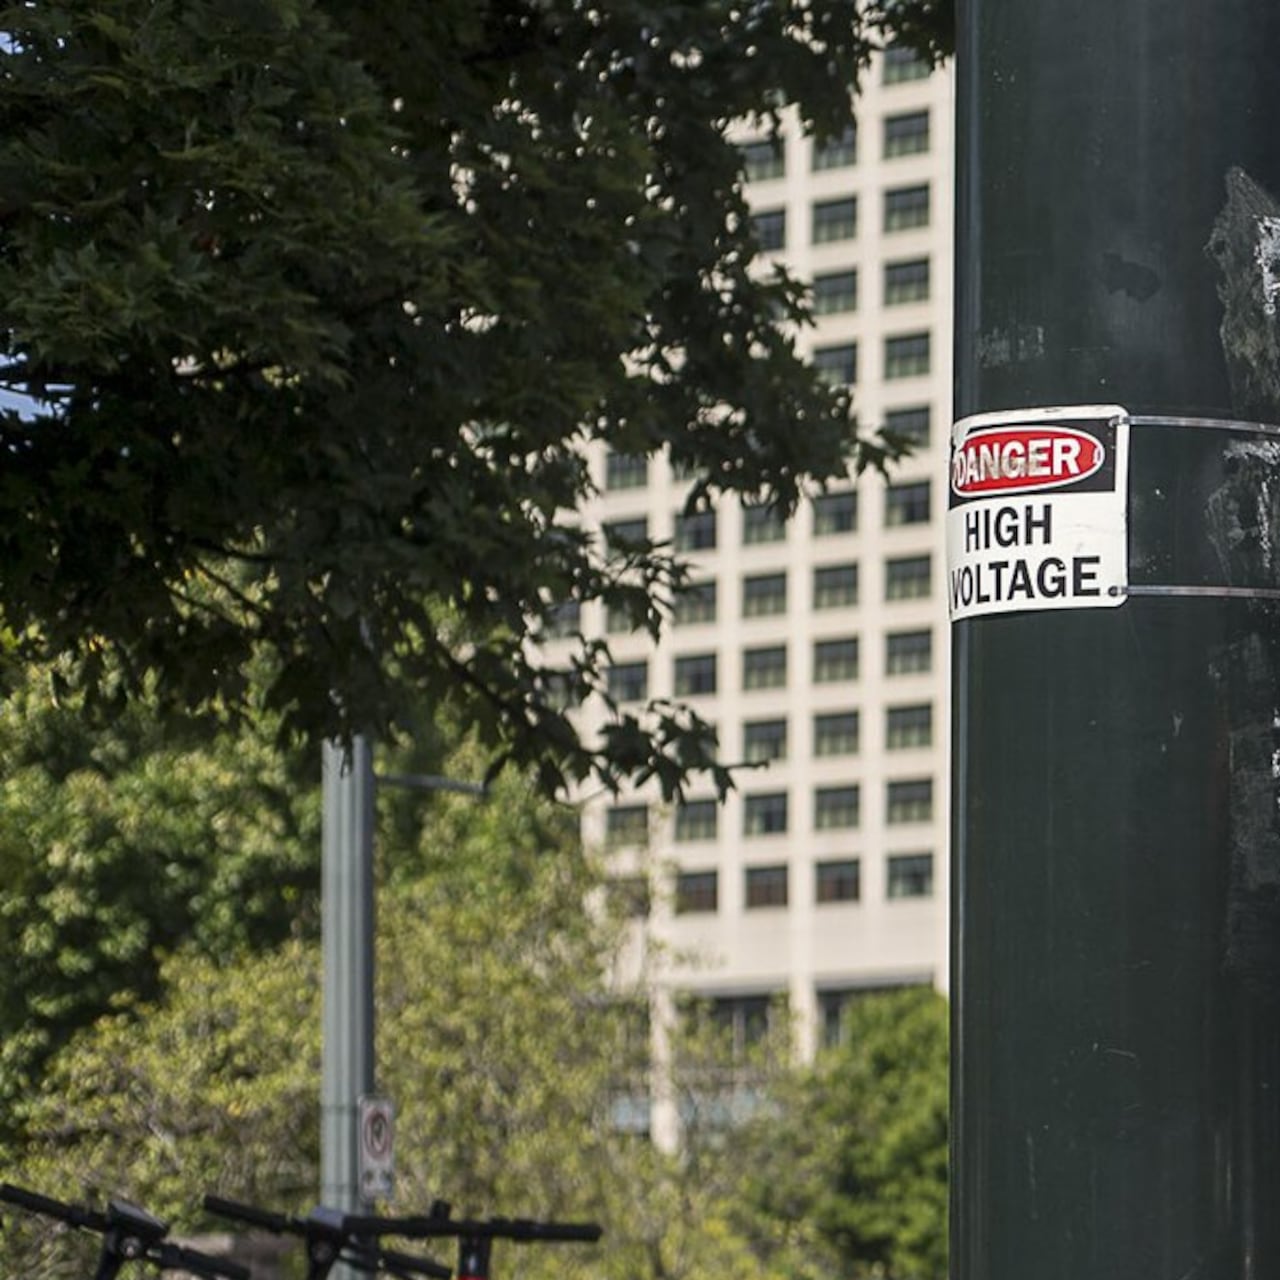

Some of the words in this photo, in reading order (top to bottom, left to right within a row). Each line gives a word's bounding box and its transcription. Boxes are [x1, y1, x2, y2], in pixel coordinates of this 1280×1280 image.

[954, 438, 1081, 487] DANGER
[966, 504, 1052, 553] HIGH
[951, 555, 1101, 609] VOLTAGE
